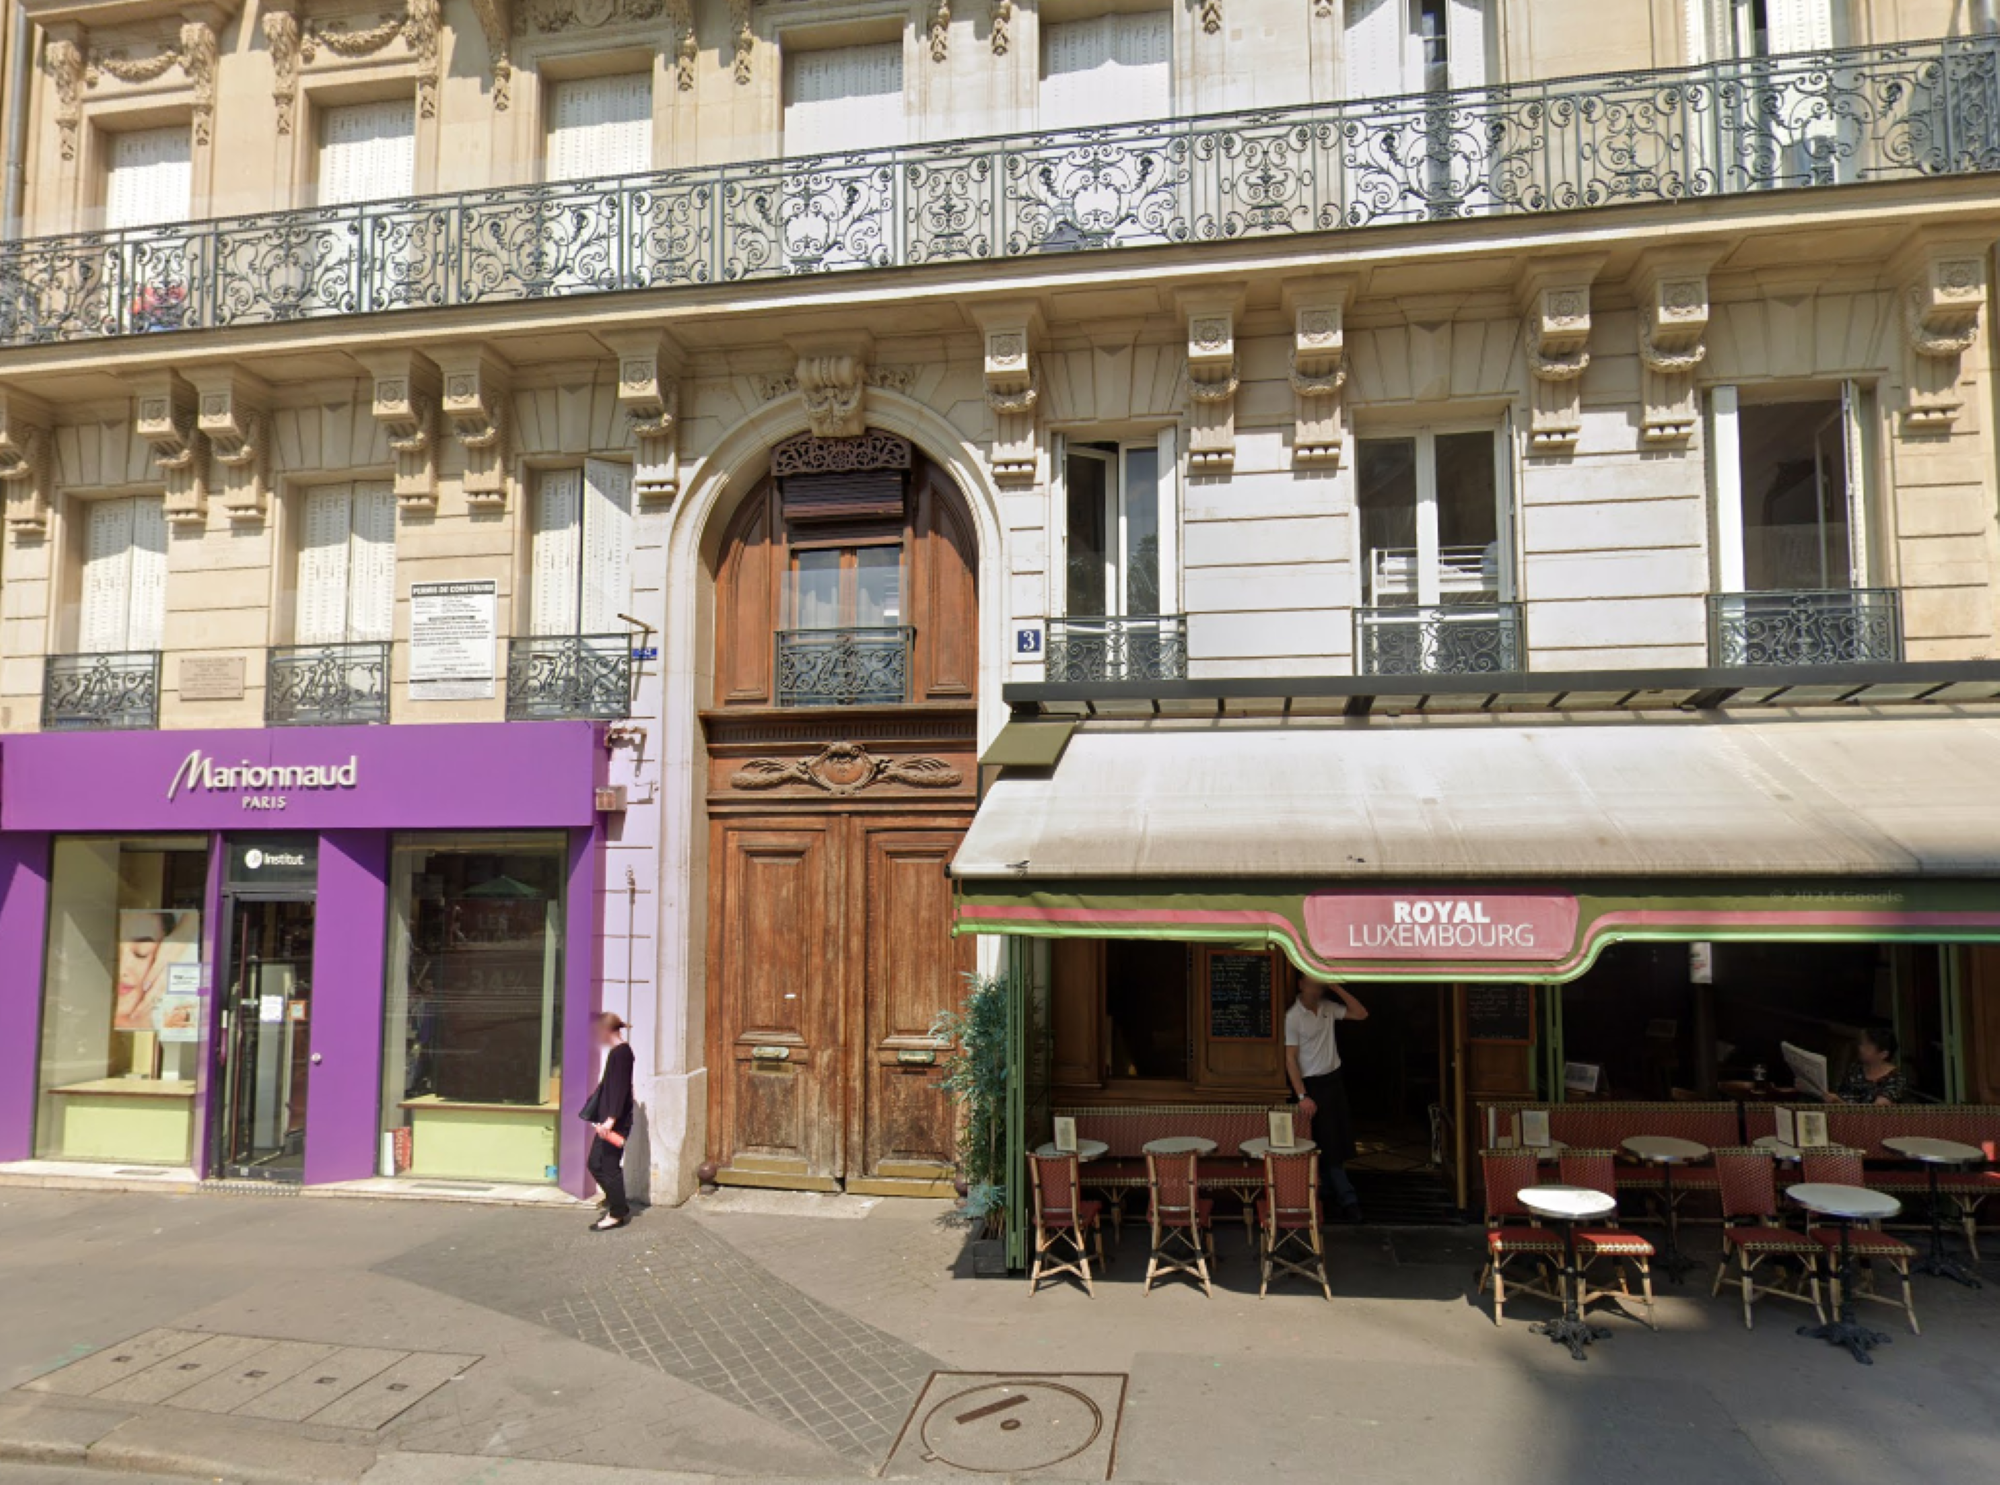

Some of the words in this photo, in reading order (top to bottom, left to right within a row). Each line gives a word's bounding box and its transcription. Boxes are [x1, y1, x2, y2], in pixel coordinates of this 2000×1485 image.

[1023, 630, 1035, 650] 3
[167, 749, 358, 800] Marionnaud
[242, 796, 287, 809] PARIS
[264, 853, 304, 865] Institut
[1393, 901, 1491, 924] ROYAL
[1349, 924, 1534, 947] LUXEMBOURG
